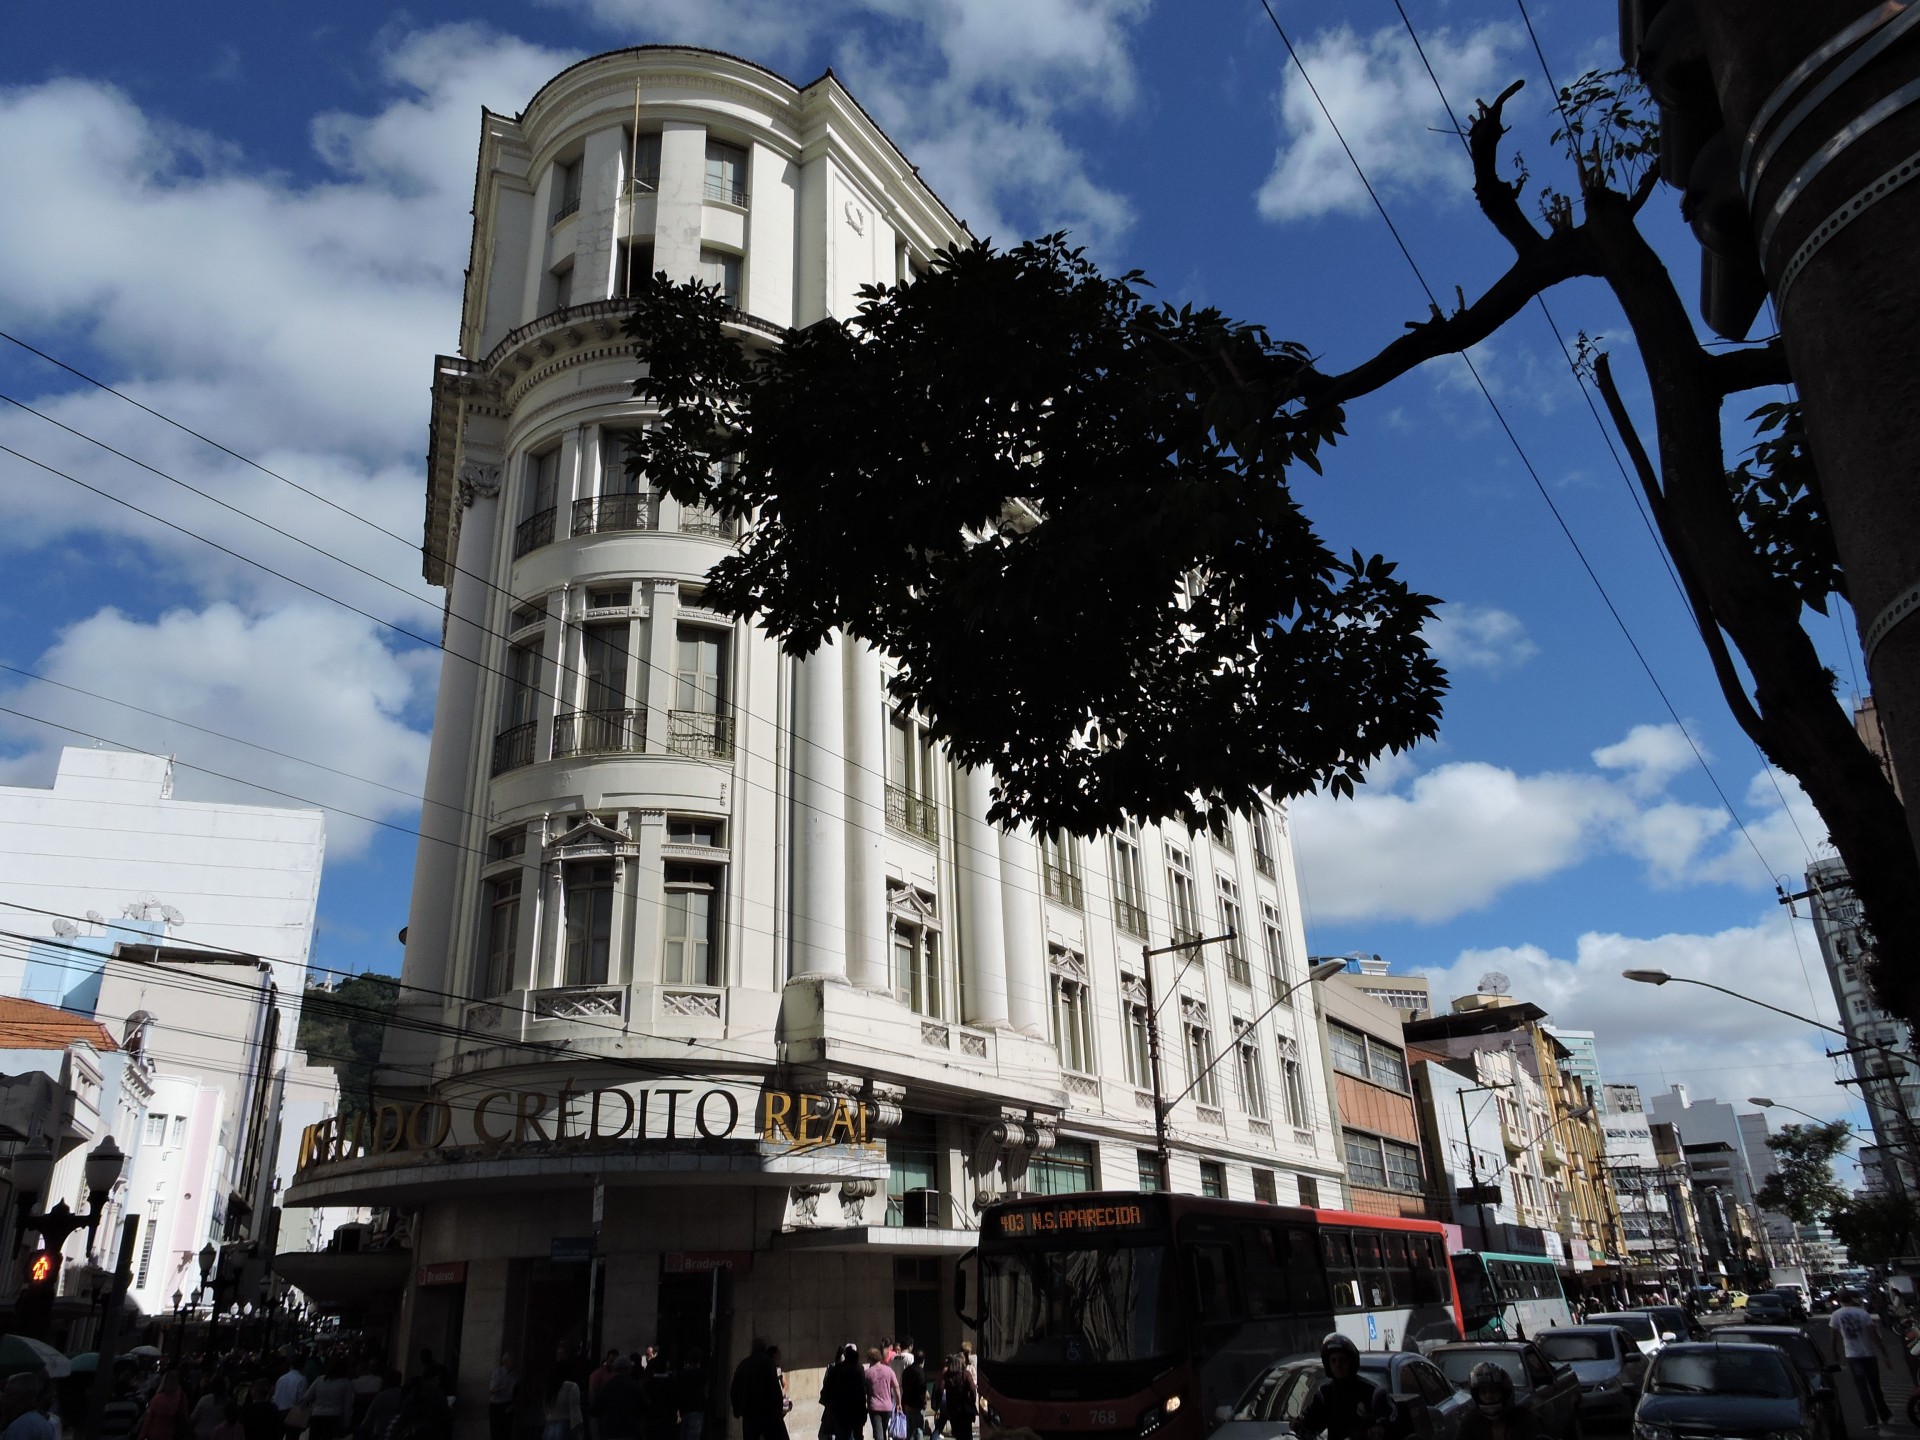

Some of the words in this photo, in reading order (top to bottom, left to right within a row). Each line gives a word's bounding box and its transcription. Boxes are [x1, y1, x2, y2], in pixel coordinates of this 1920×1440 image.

[371, 1101, 451, 1155] DO
[473, 1076, 739, 1144] CRÉDITO
[764, 1091, 877, 1144] REAL
[1000, 1213, 1025, 1232] 403
[1089, 1409, 1117, 1425] 768
